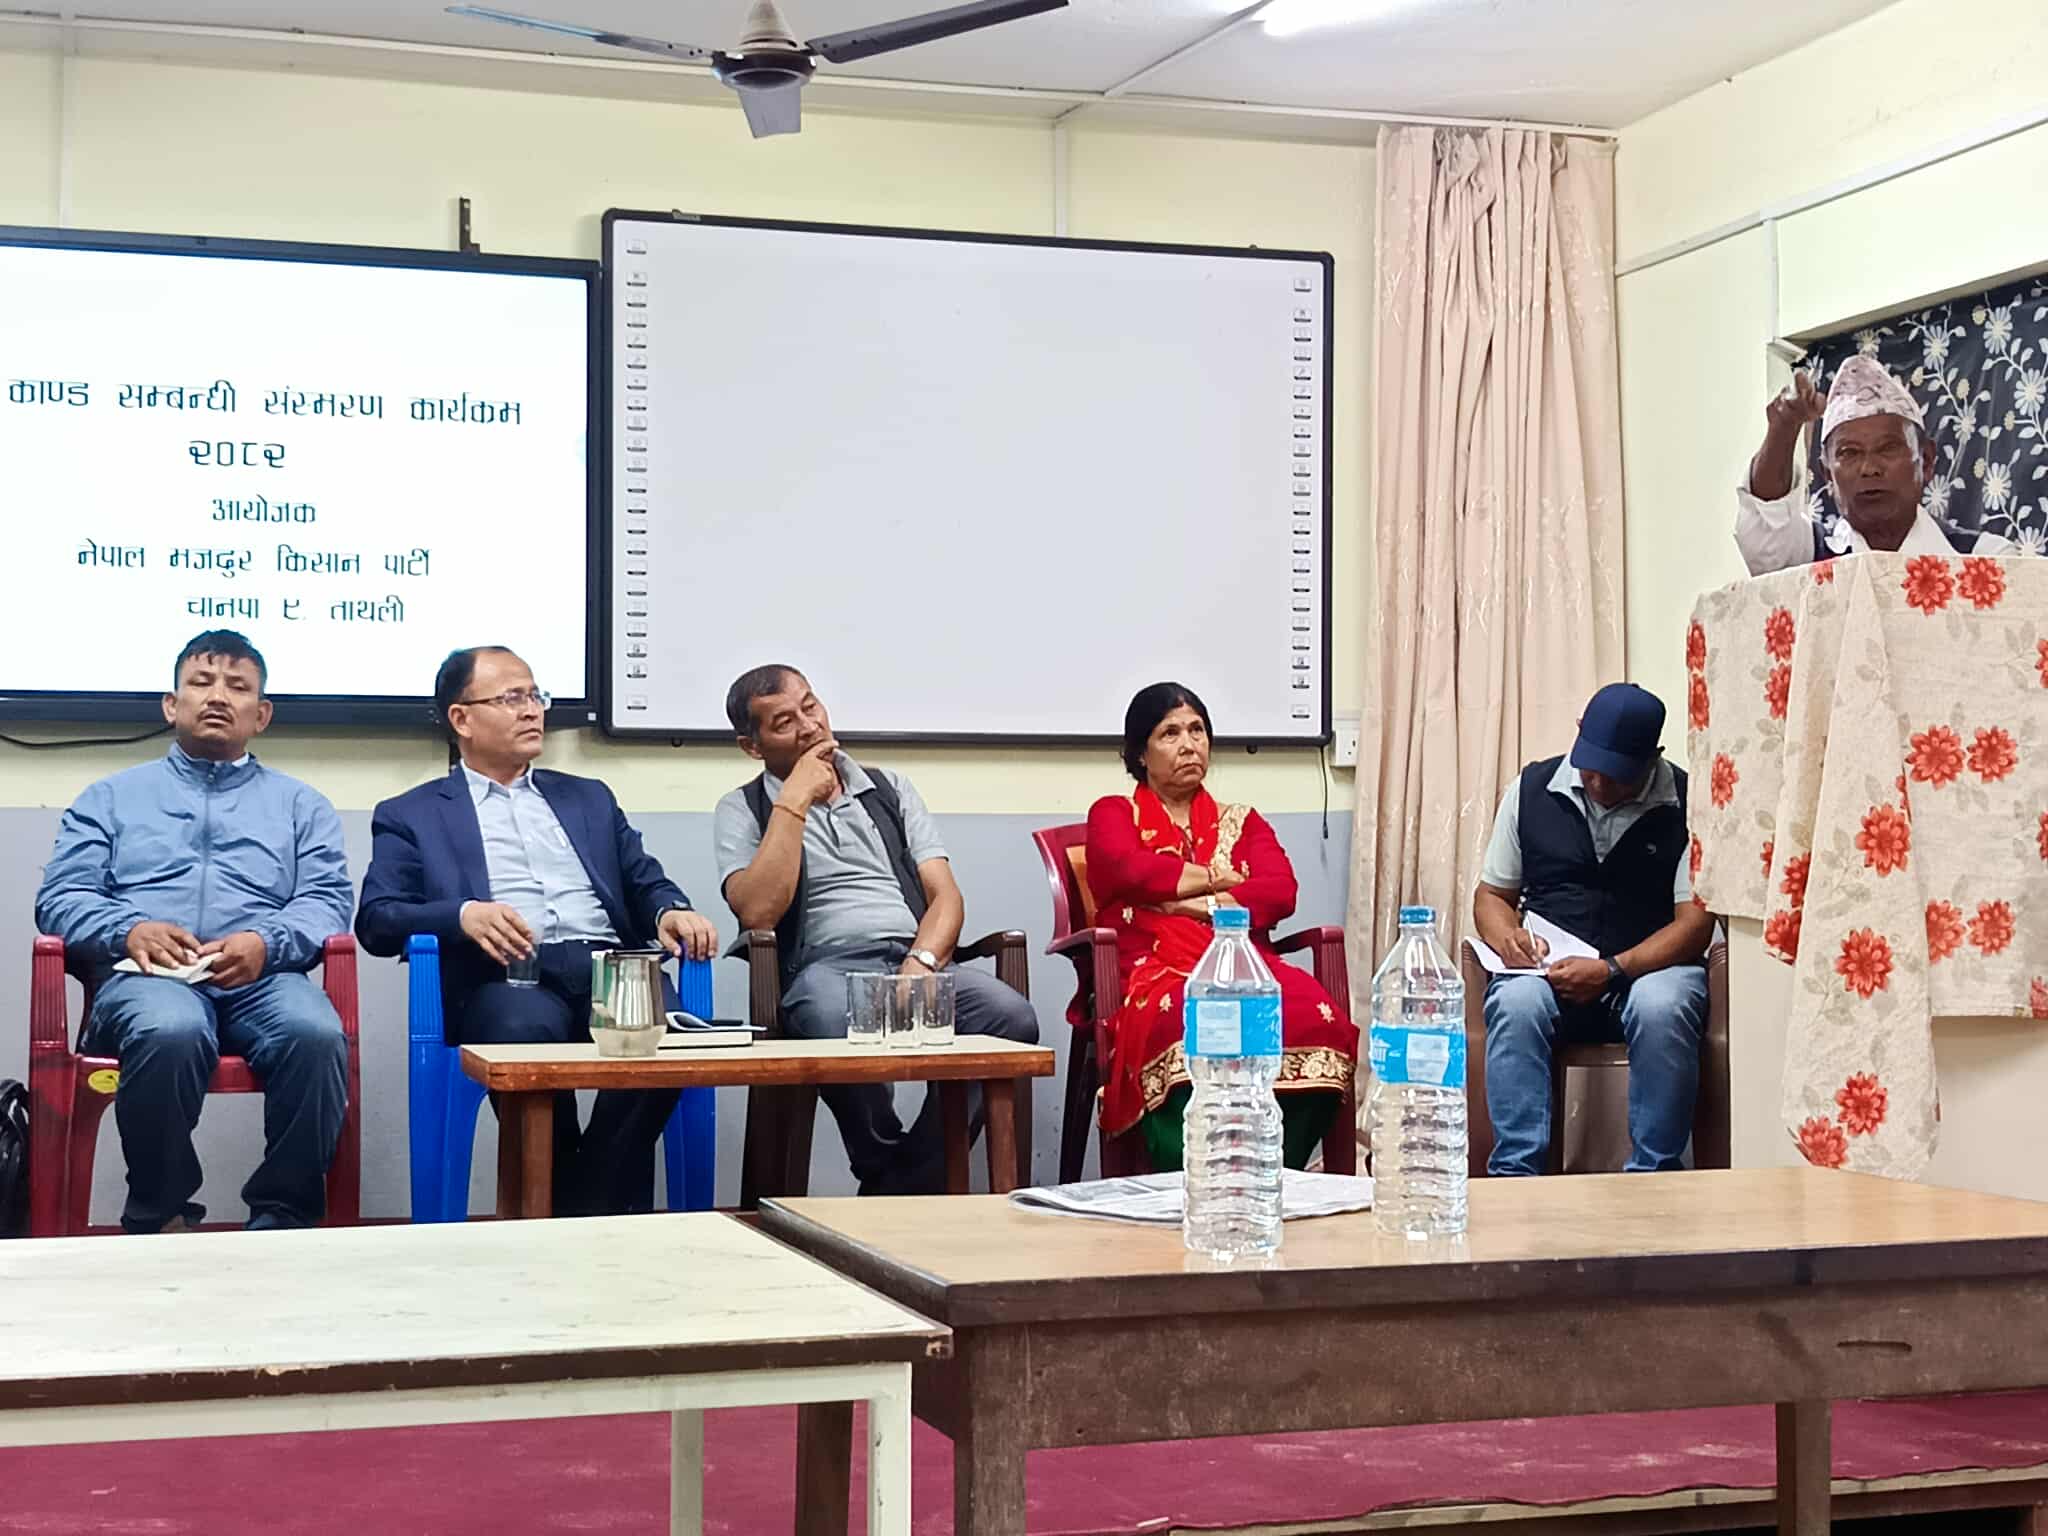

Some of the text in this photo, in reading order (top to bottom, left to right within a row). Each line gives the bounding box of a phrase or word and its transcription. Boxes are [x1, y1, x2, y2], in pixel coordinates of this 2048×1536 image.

[8, 379, 89, 406] काण्ड
[264, 385, 383, 419] संस्मरण
[188, 440, 285, 468] २०८२
[212, 494, 316, 524] आयोजक
[78, 538, 430, 578] नेपाल मजदुर किसान पार्टी
[187, 596, 260, 619] चानपा
[330, 594, 404, 622] ताथली
